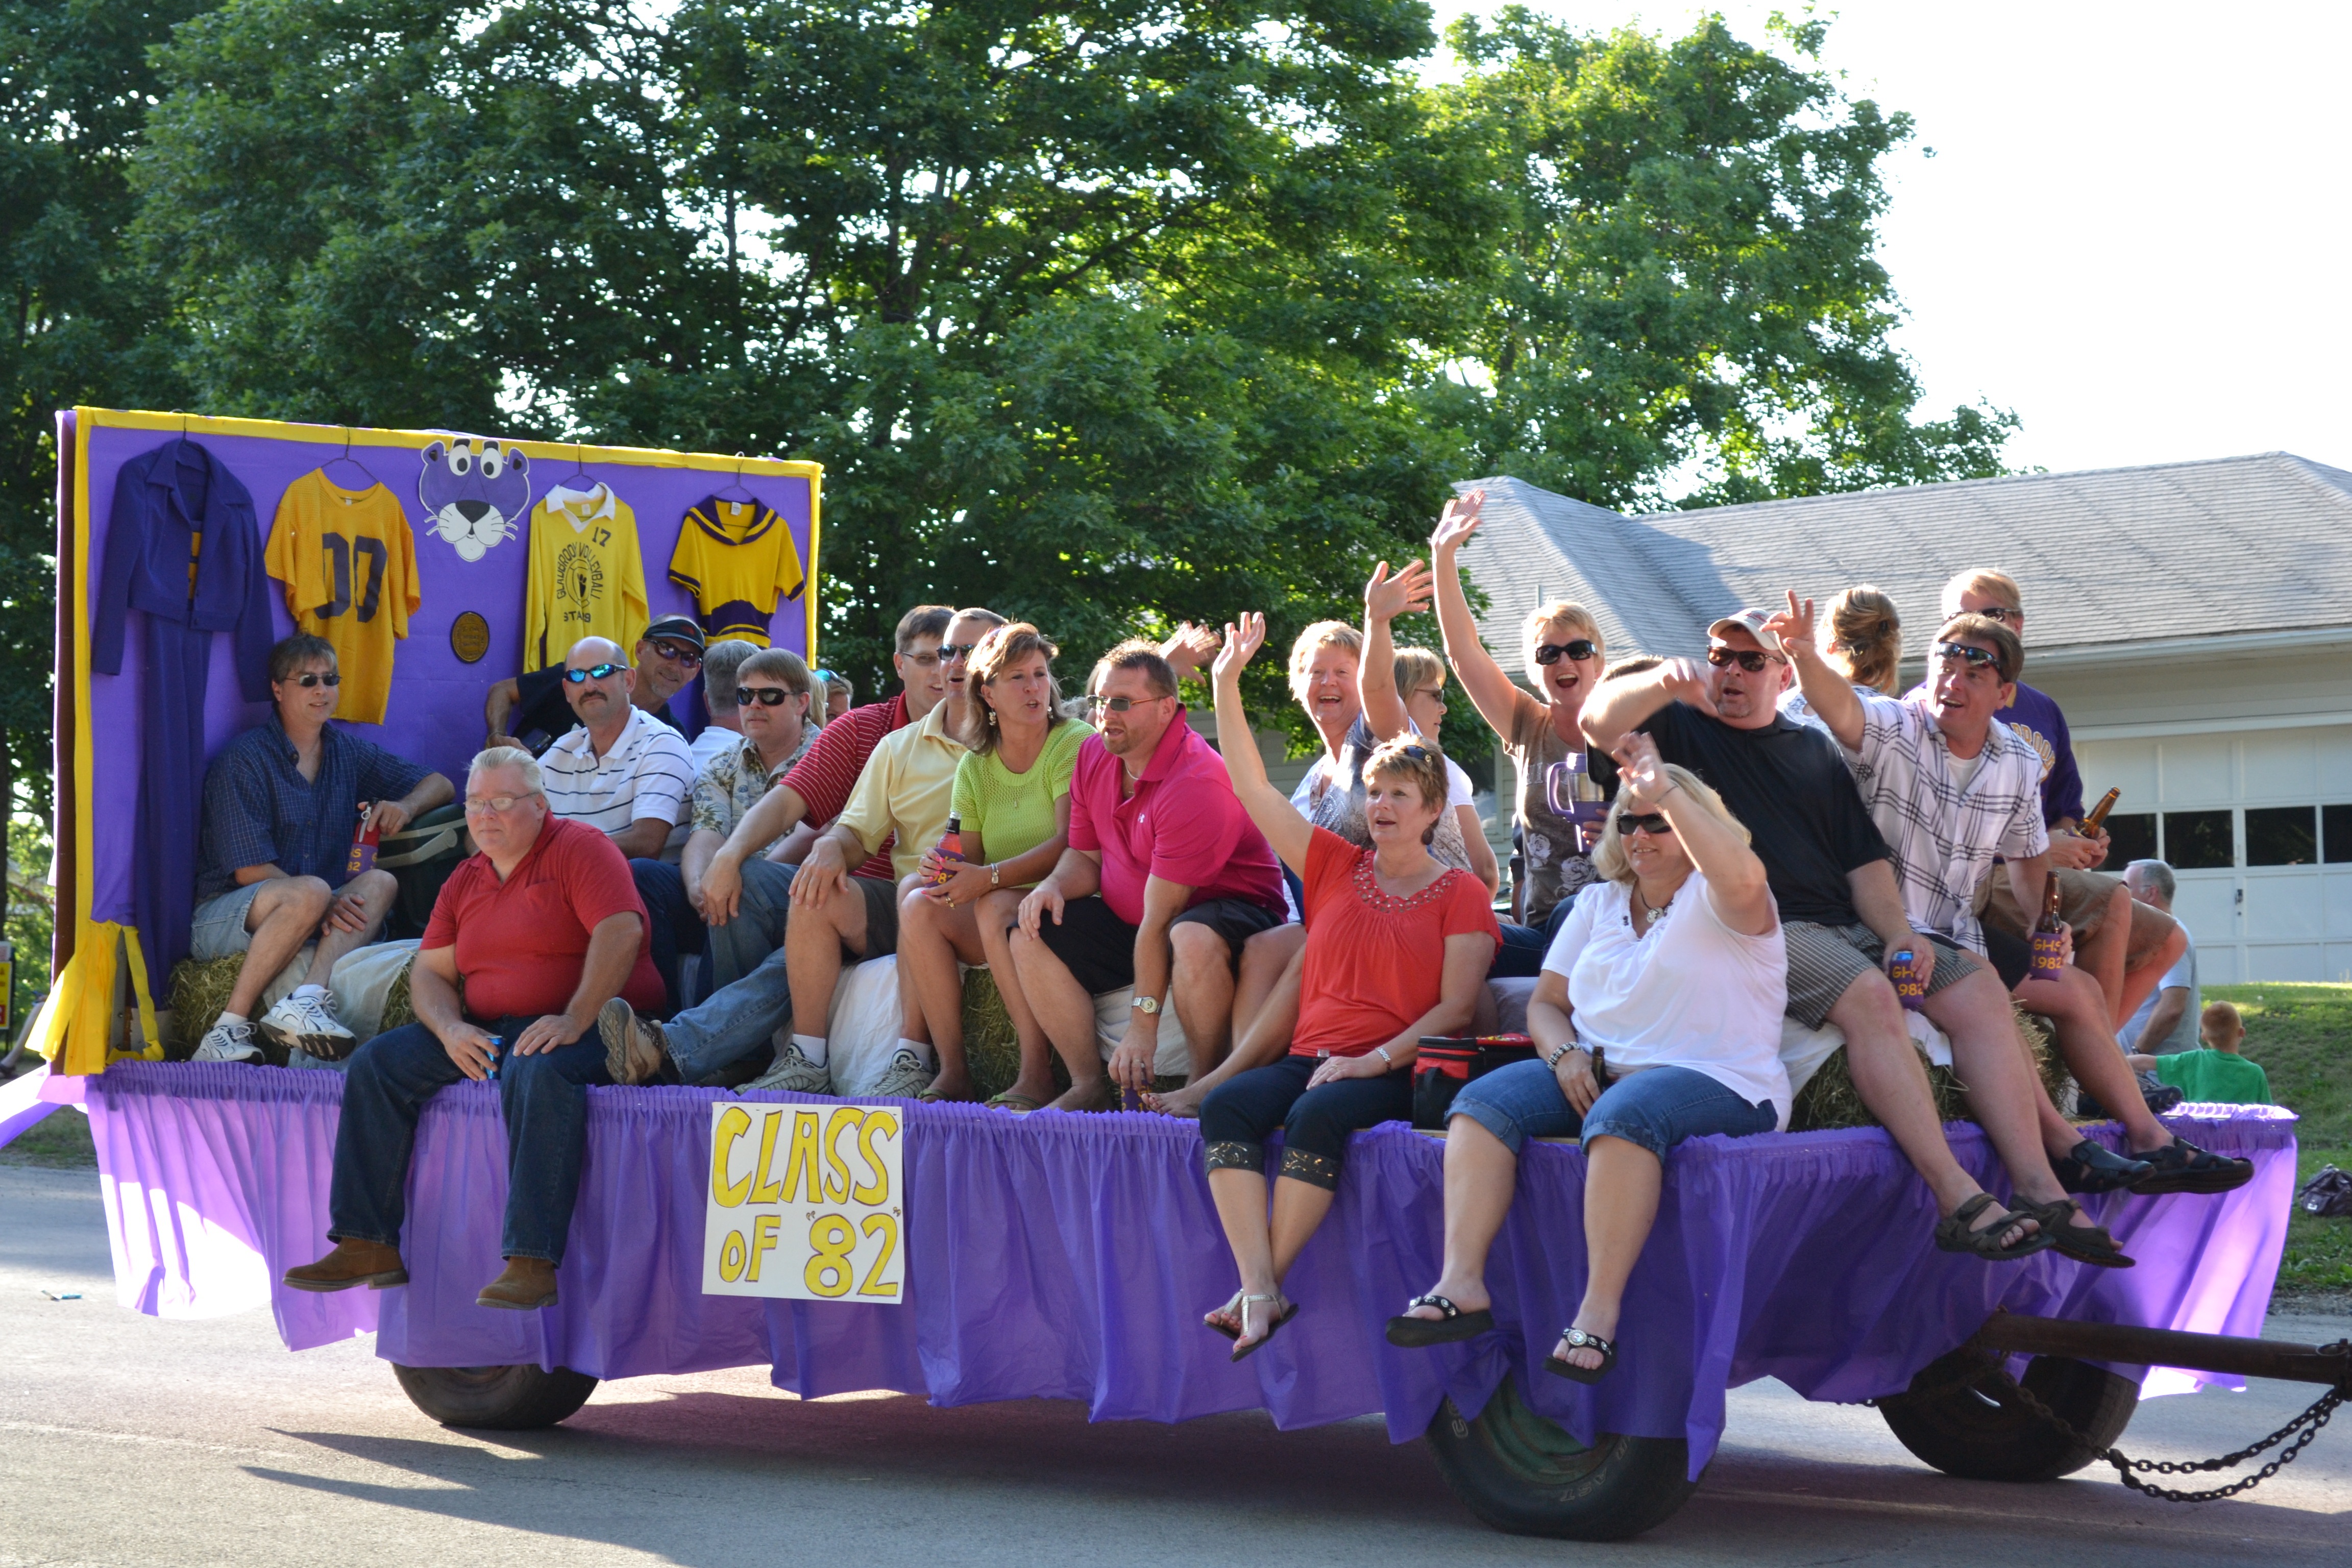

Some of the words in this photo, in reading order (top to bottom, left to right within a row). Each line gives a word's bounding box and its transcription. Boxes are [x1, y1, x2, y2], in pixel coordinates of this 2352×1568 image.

[592, 526, 611, 547] 17
[564, 610, 591, 623] STAS
[2010, 722, 2055, 771] BROOK
[2032, 955, 2063, 969] 1982
[1892, 966, 1915, 978] GH
[1898, 984, 1924, 996] 982
[712, 1106, 898, 1208] CLASS
[719, 1214, 781, 1283] OF
